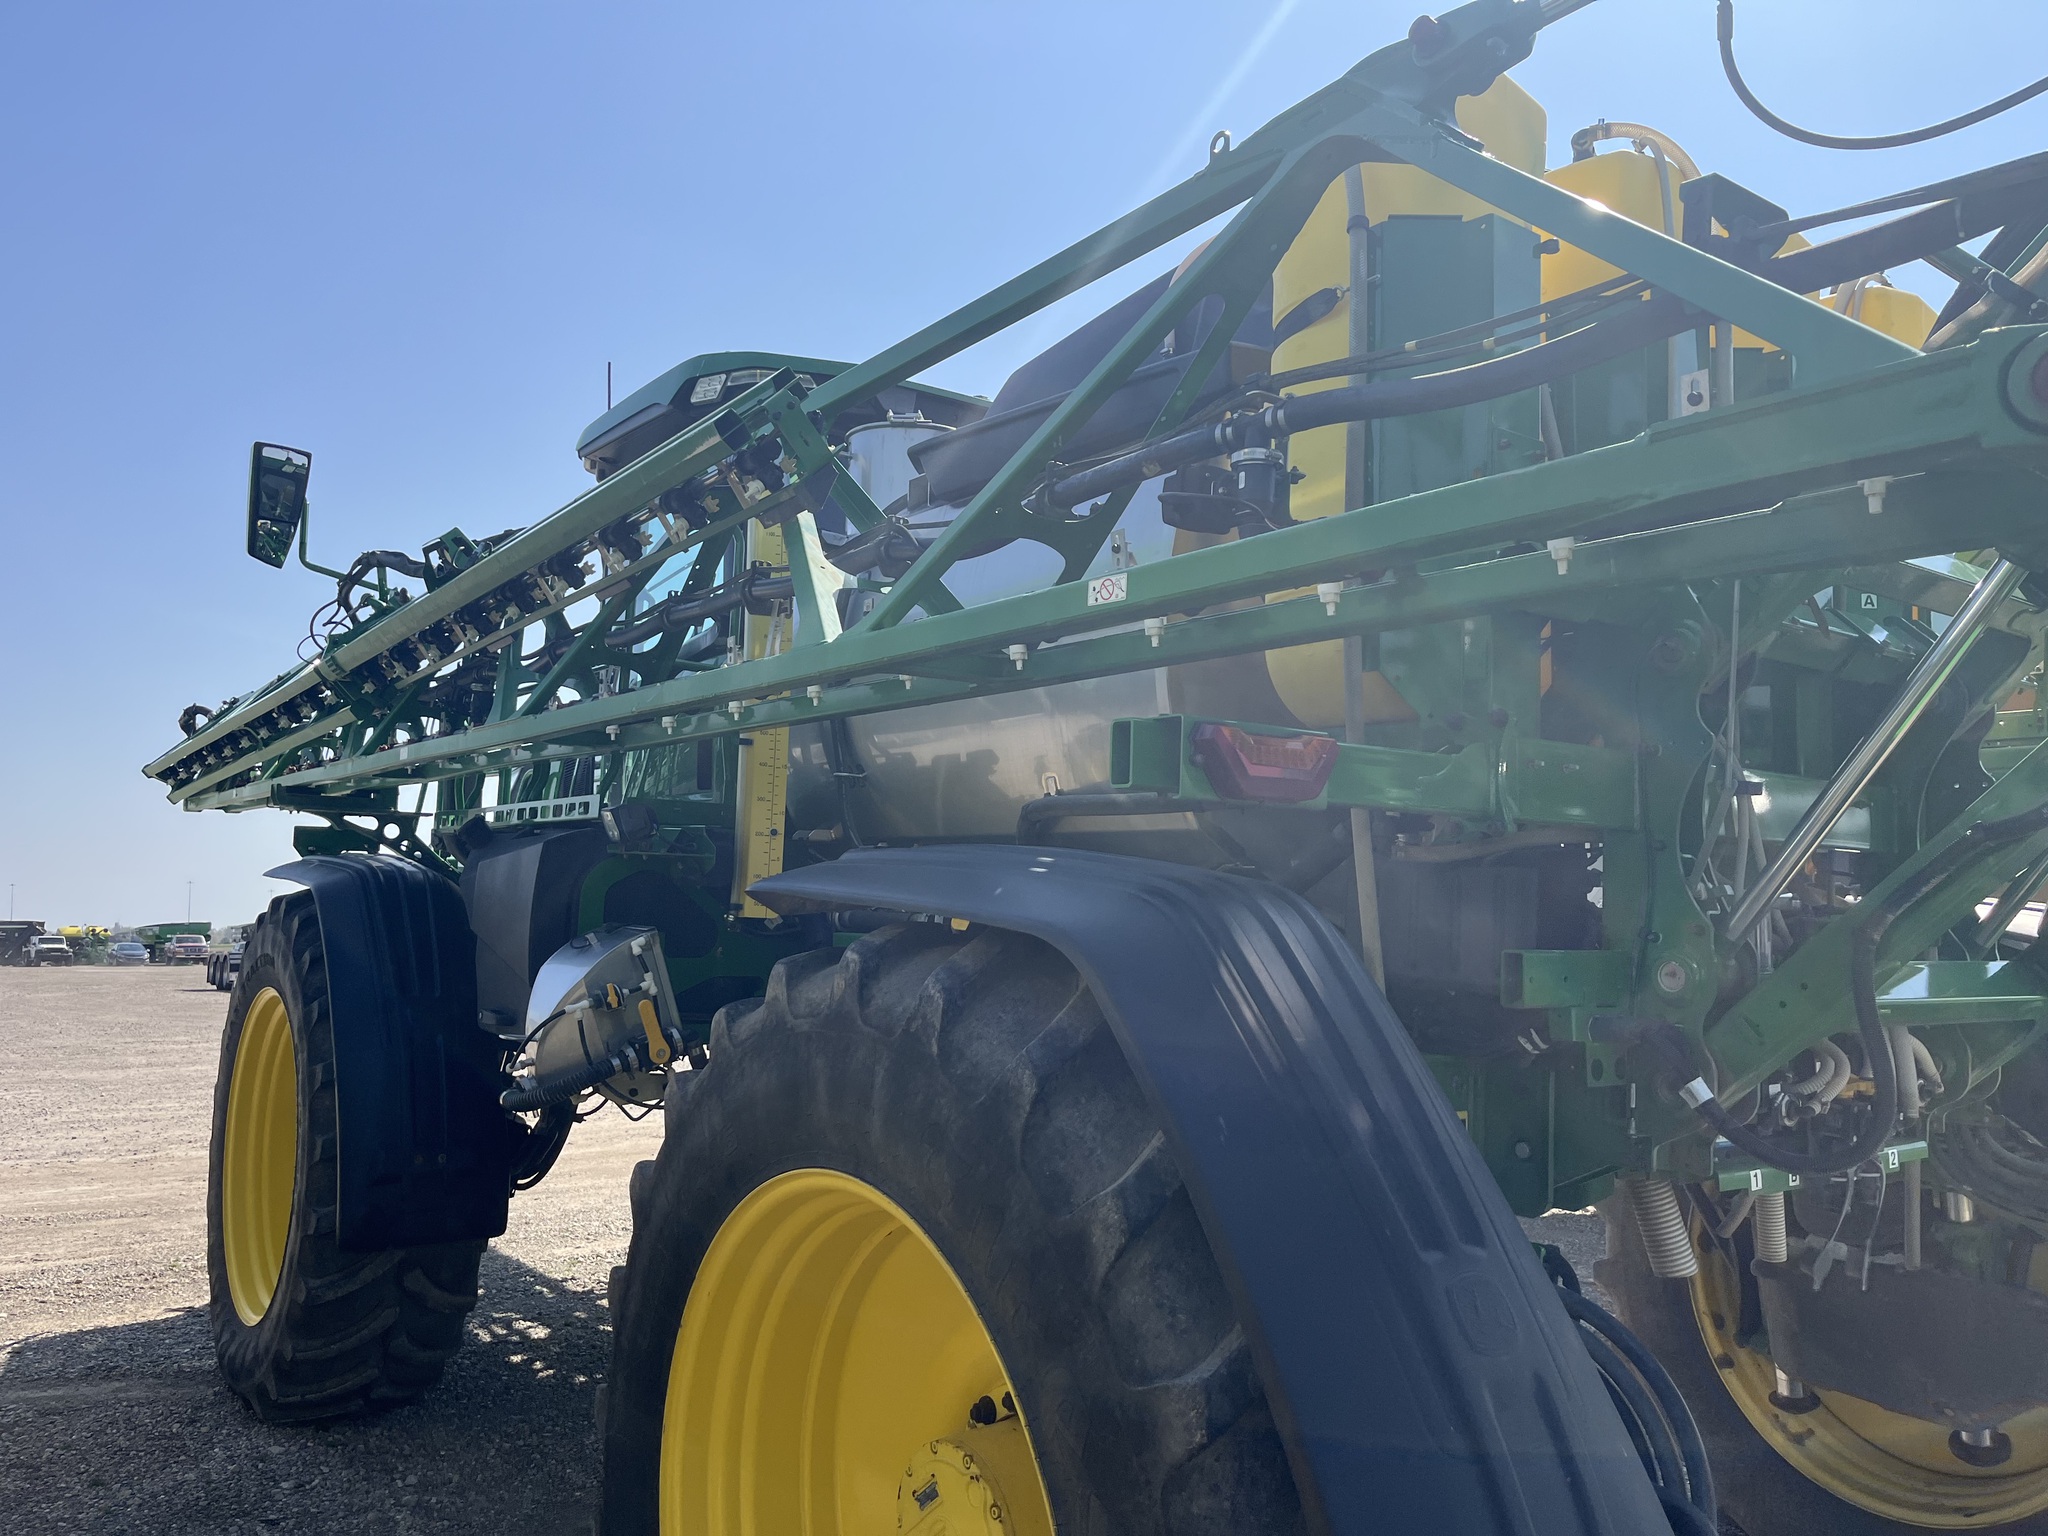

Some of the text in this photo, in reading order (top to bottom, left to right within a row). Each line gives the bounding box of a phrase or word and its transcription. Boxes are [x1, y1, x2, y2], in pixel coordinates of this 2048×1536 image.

[1864, 594, 1875, 607] A
[1890, 1151, 1897, 1166] 2
[1753, 1172, 1759, 1188] 1
